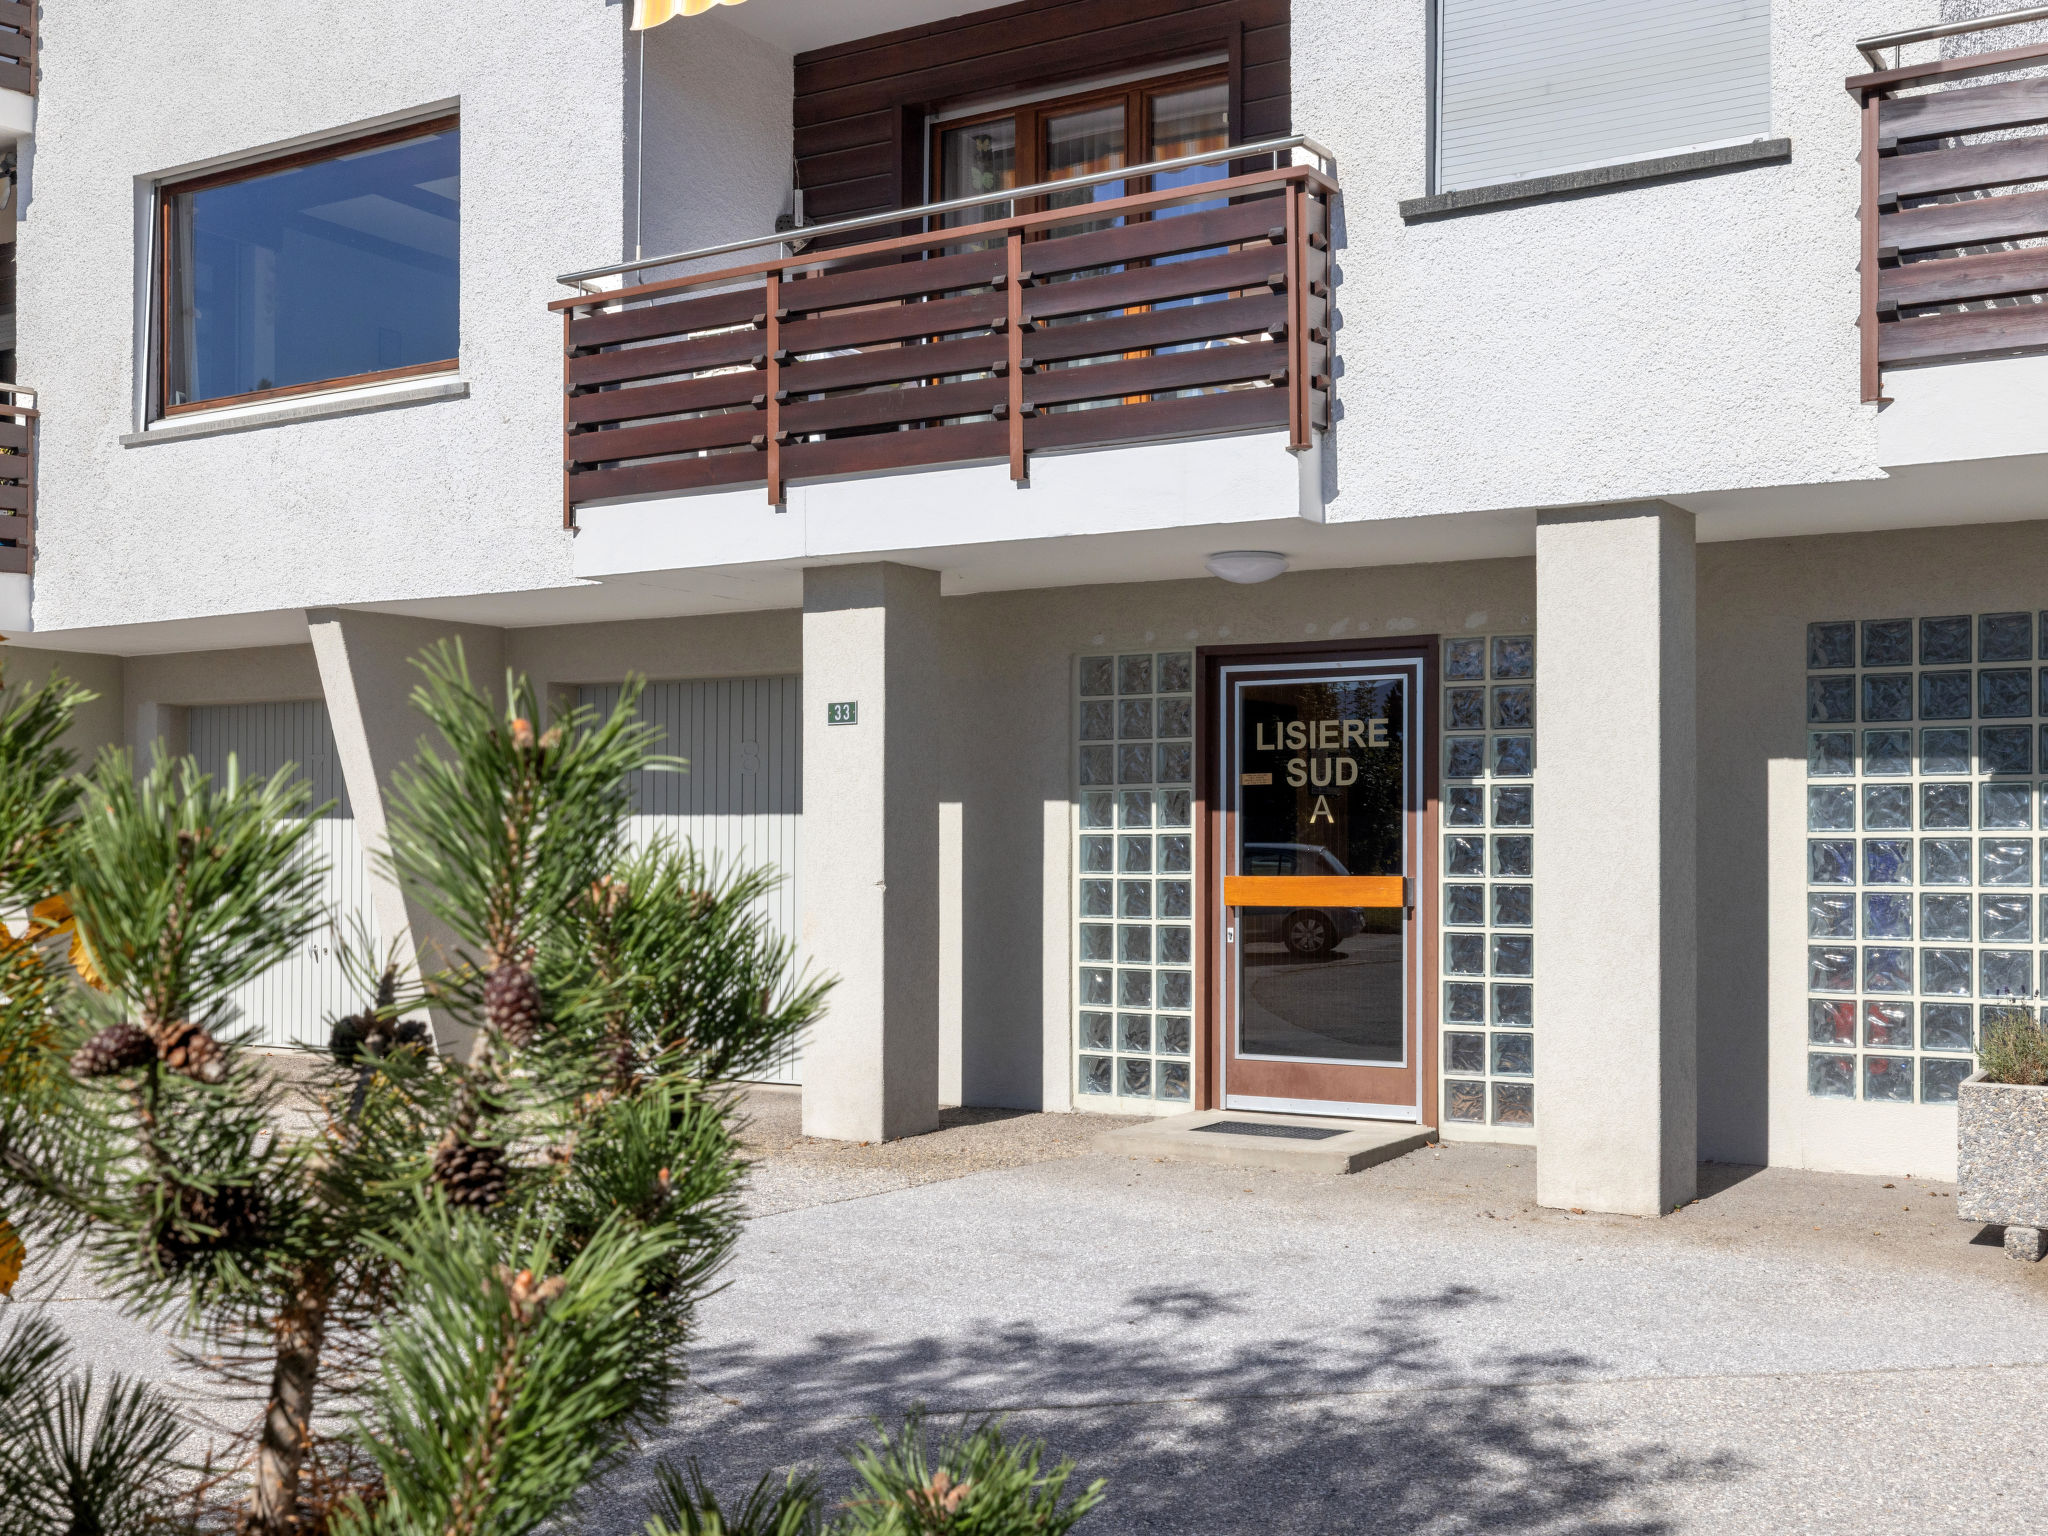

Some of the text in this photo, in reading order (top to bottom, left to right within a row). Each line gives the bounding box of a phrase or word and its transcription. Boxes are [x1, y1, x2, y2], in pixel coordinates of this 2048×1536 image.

[834, 704, 850, 721] 33
[1256, 718, 1390, 750] LISIERE
[1286, 757, 1359, 788] SUD
[1309, 794, 1335, 824] A
